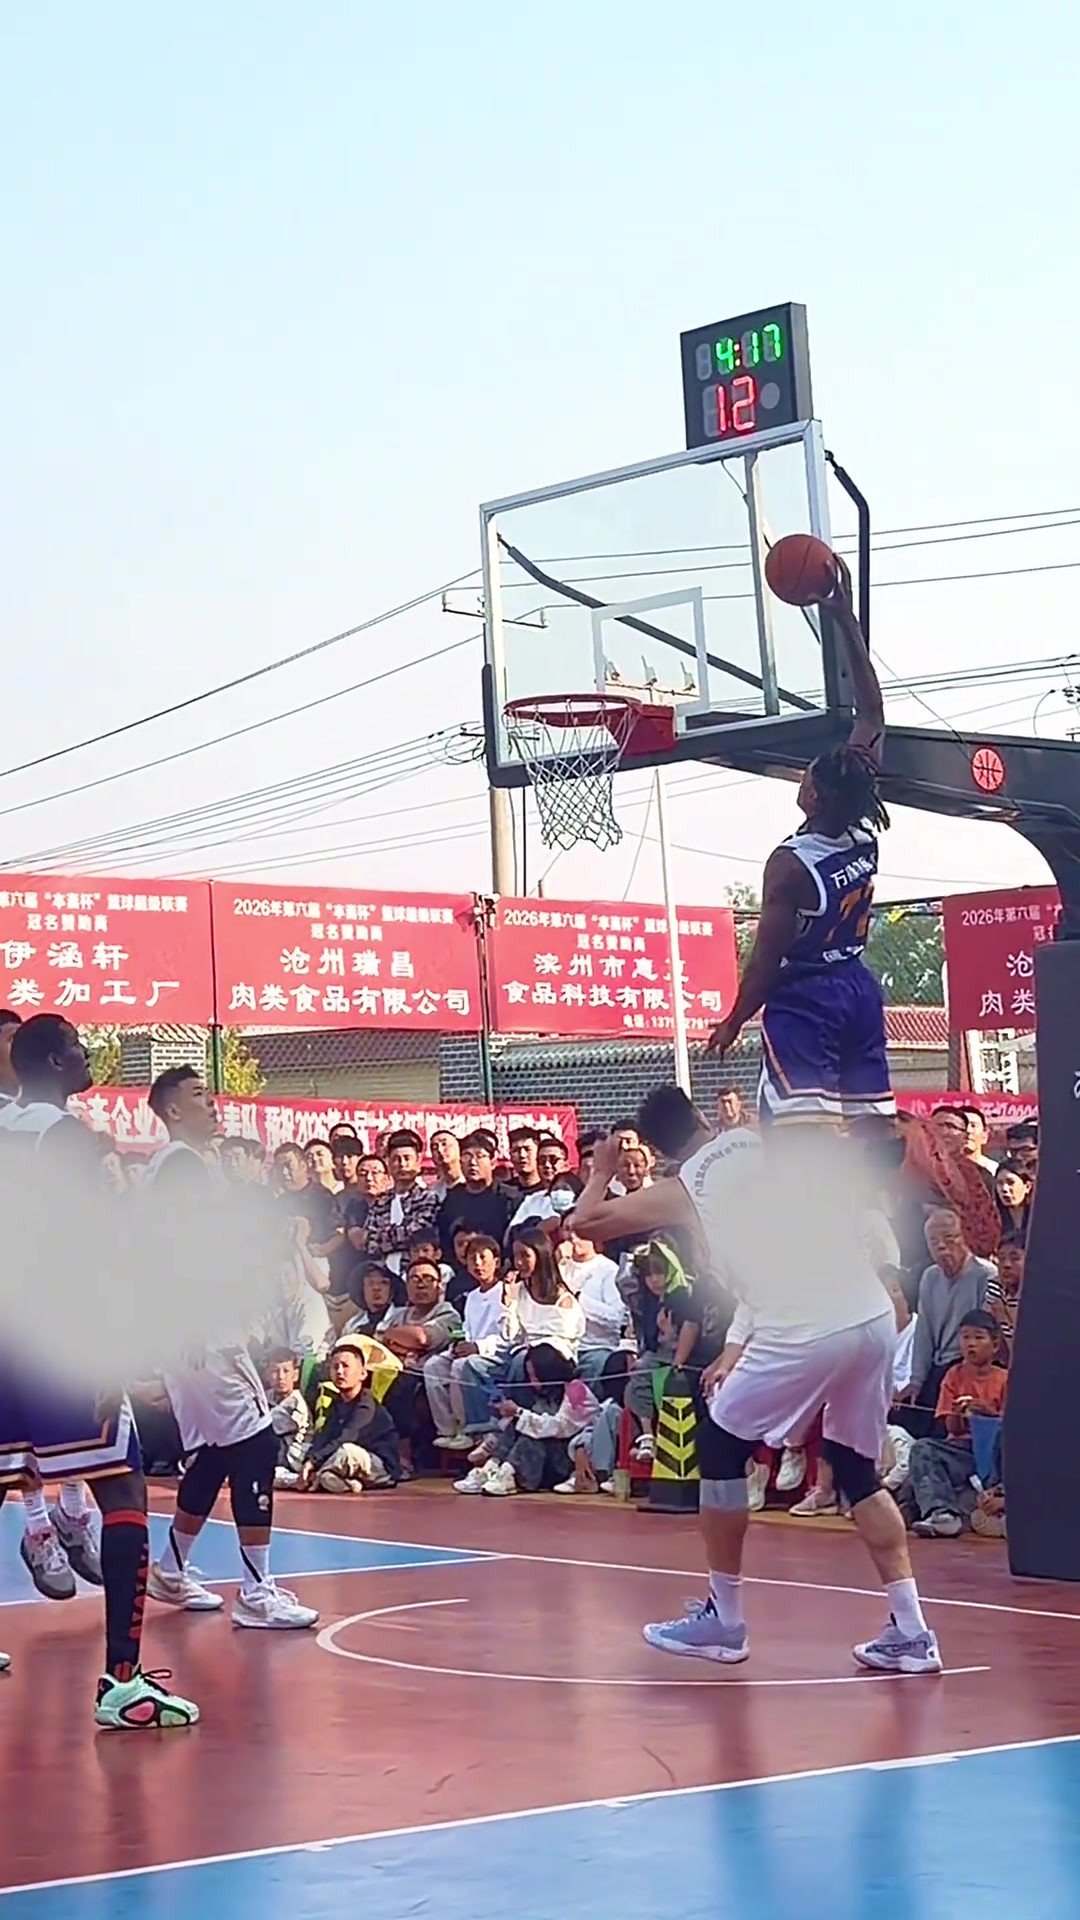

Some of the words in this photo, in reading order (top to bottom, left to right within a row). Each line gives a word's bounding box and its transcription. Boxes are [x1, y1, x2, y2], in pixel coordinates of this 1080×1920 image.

[715, 323, 781, 371] 4:17
[718, 375, 755, 431] 12
[0, 940, 129, 970] 伊涵轩
[280, 946, 414, 978] 沧州瑞昌
[7, 977, 180, 1007] 类加工厂
[228, 982, 470, 1016] 肉类食品有限公司
[502, 981, 721, 1012] 食品科技有限公司
[979, 989, 1035, 1017] 肉类
